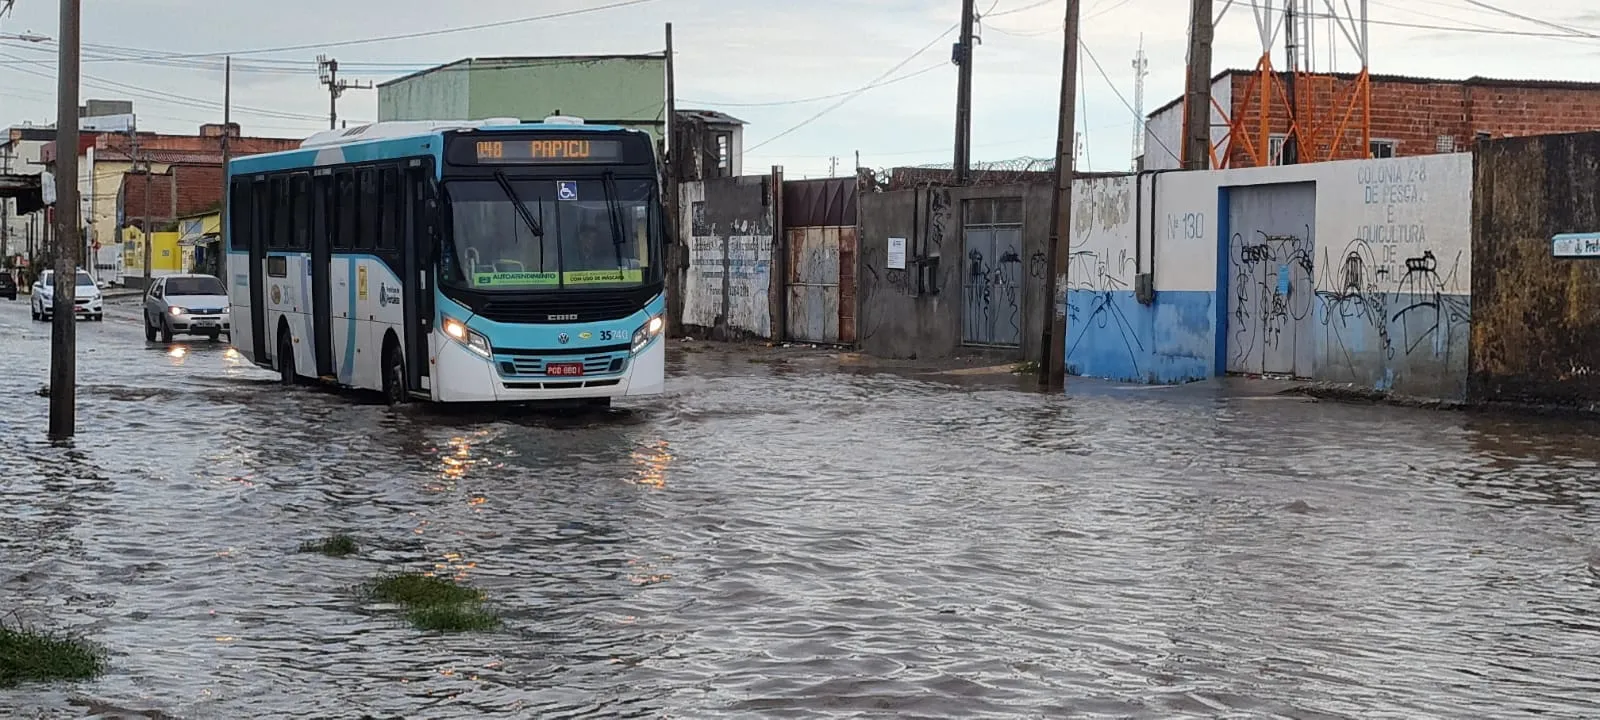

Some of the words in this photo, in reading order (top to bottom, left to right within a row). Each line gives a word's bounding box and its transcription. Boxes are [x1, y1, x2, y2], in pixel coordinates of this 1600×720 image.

[531, 140, 590, 158] PAPICU
[1365, 185, 1379, 204] DE
[1387, 204, 1395, 223] E
[1182, 212, 1204, 240] 130
[1357, 224, 1425, 243] AQUICULTURA
[1383, 244, 1397, 263] DE
